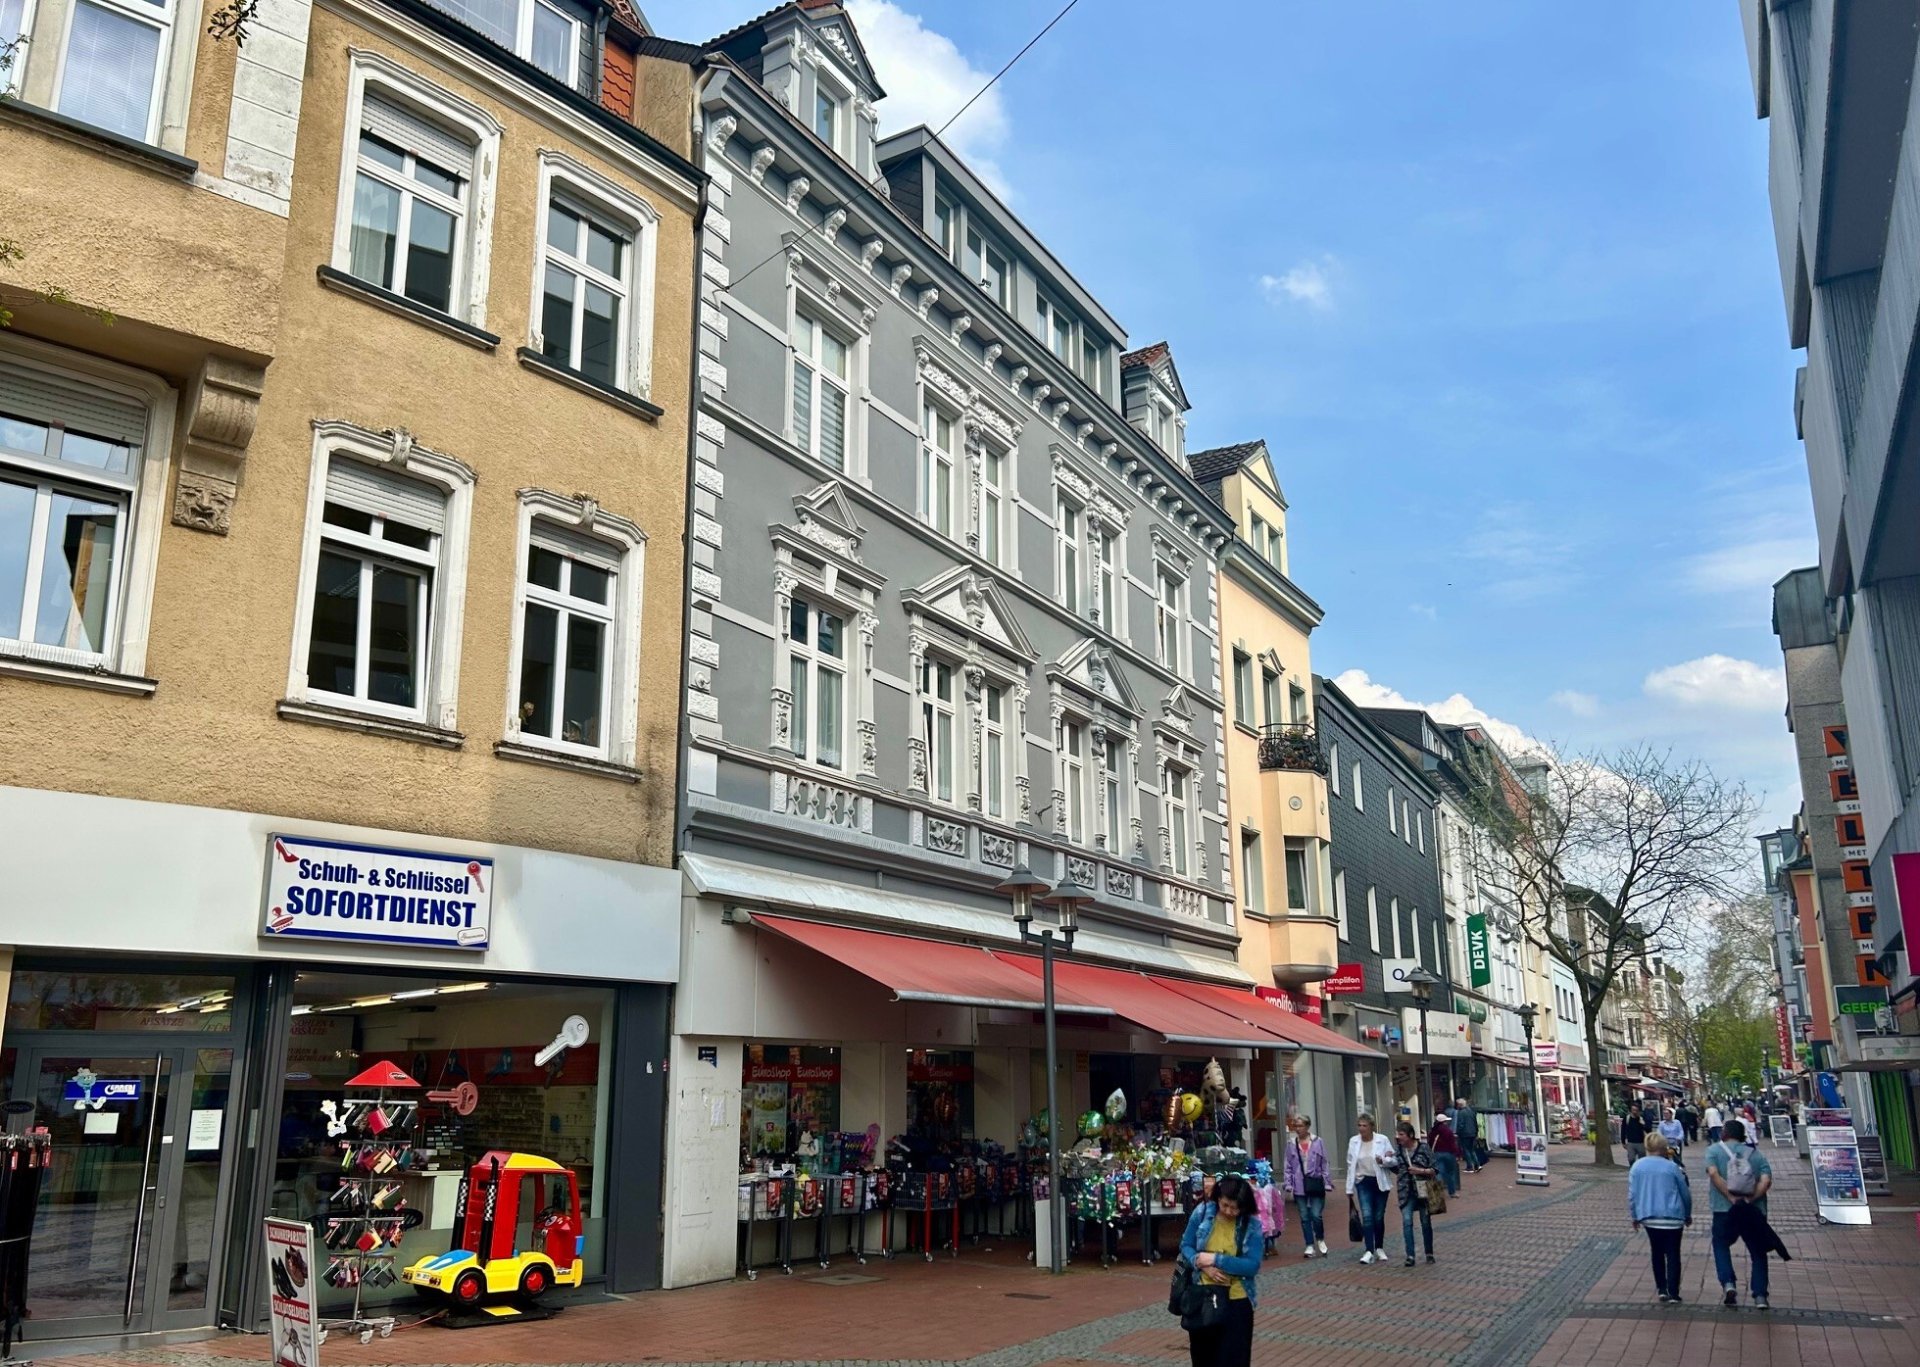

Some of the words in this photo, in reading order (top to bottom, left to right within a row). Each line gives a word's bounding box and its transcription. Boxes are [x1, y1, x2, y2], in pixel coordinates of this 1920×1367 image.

[299, 858, 364, 884] Schuh-
[368, 868, 381, 887] &
[385, 867, 470, 895] Schlüssel
[286, 886, 477, 928] SOFORTDIENST
[1471, 930, 1486, 970] DEVK
[1326, 977, 1361, 985] amplifon
